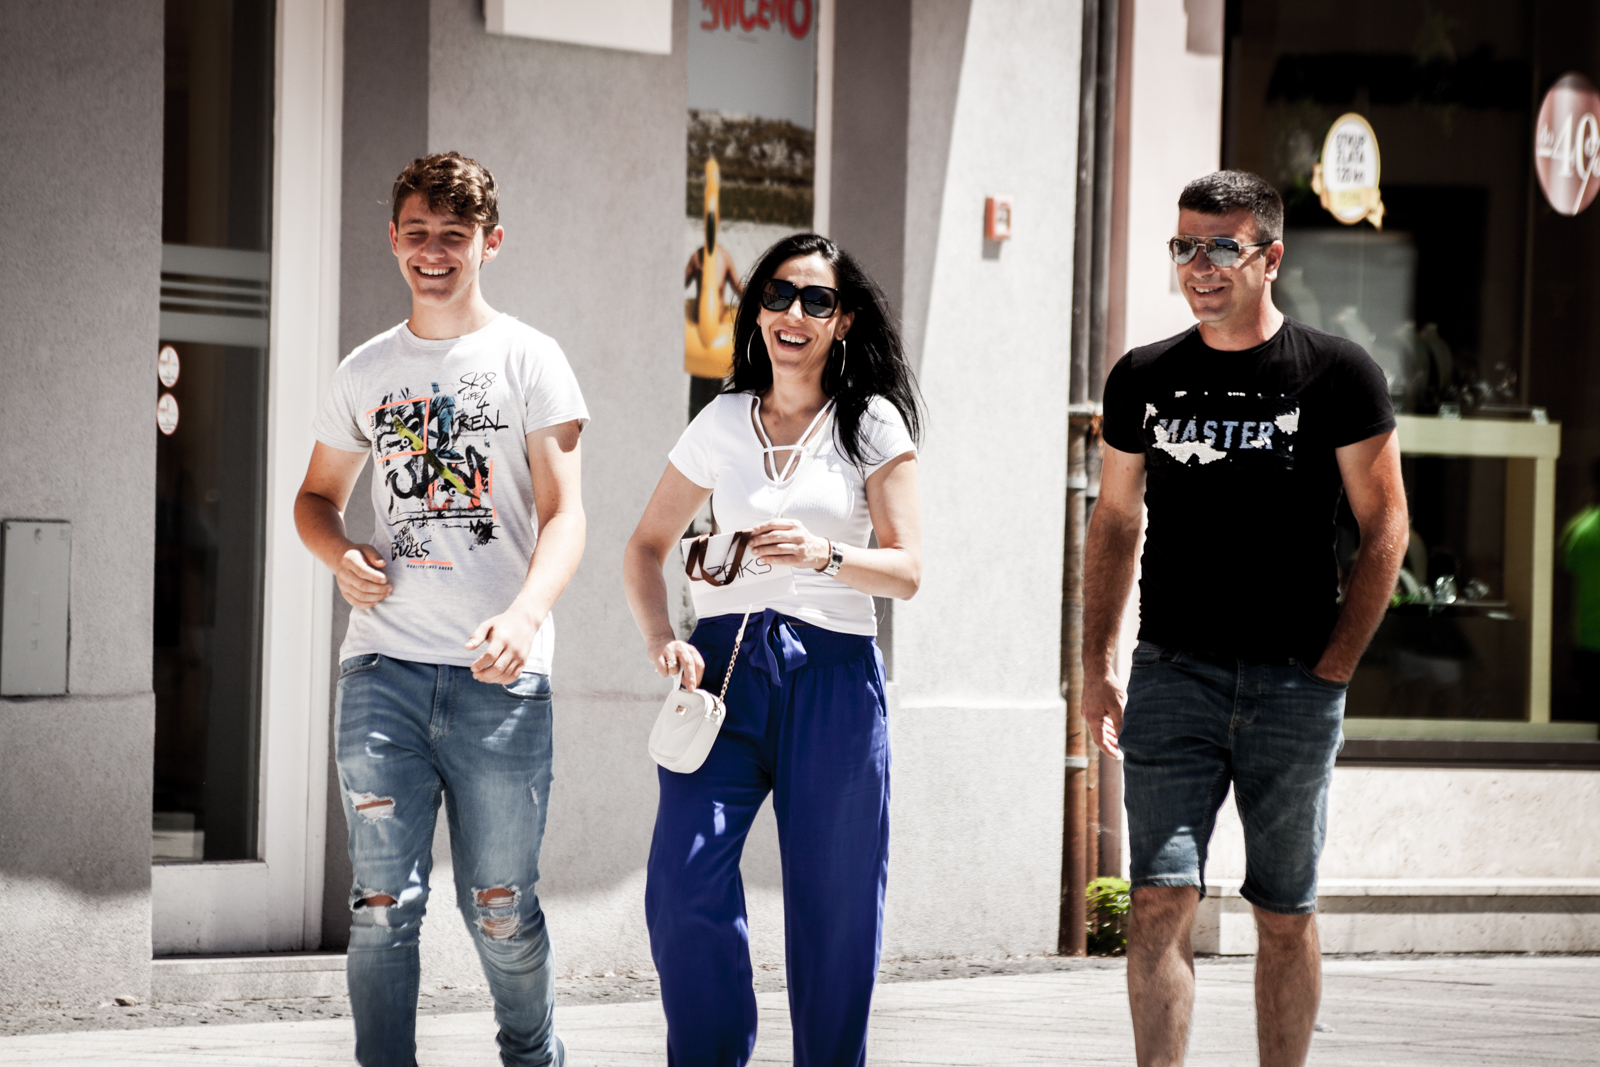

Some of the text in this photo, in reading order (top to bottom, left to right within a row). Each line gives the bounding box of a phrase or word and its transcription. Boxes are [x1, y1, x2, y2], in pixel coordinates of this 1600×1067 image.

[458, 371, 497, 394] SK8
[455, 409, 509, 432] REAL
[1158, 418, 1275, 450] MASTER
